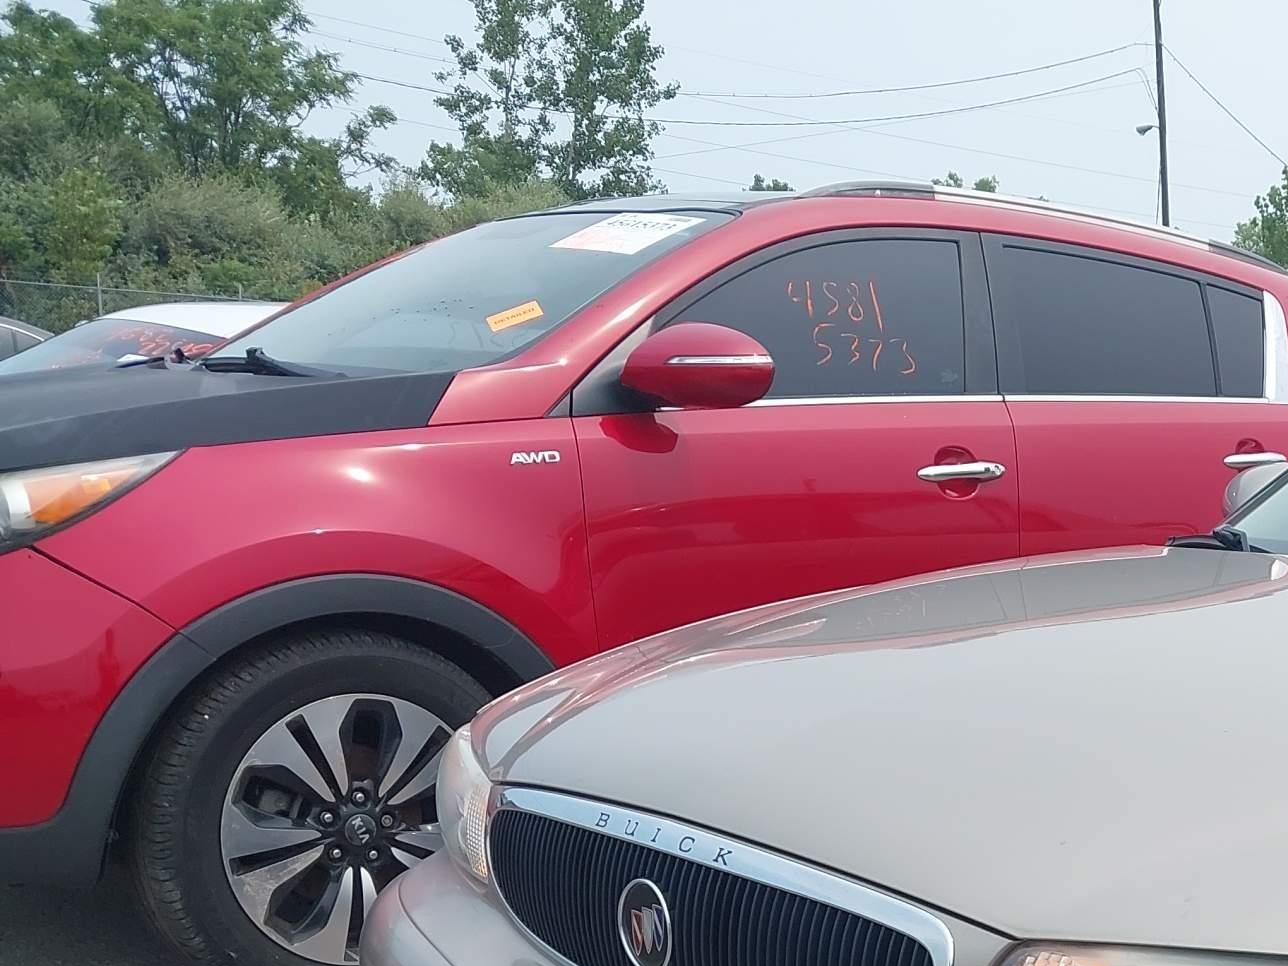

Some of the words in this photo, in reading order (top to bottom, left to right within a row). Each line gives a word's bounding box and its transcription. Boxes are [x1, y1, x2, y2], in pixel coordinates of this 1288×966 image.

[786, 280, 883, 333] 4581
[812, 322, 916, 375] 5373
[510, 450, 561, 465] AWD
[352, 817, 370, 844] KIA
[595, 811, 733, 867] BUICK
